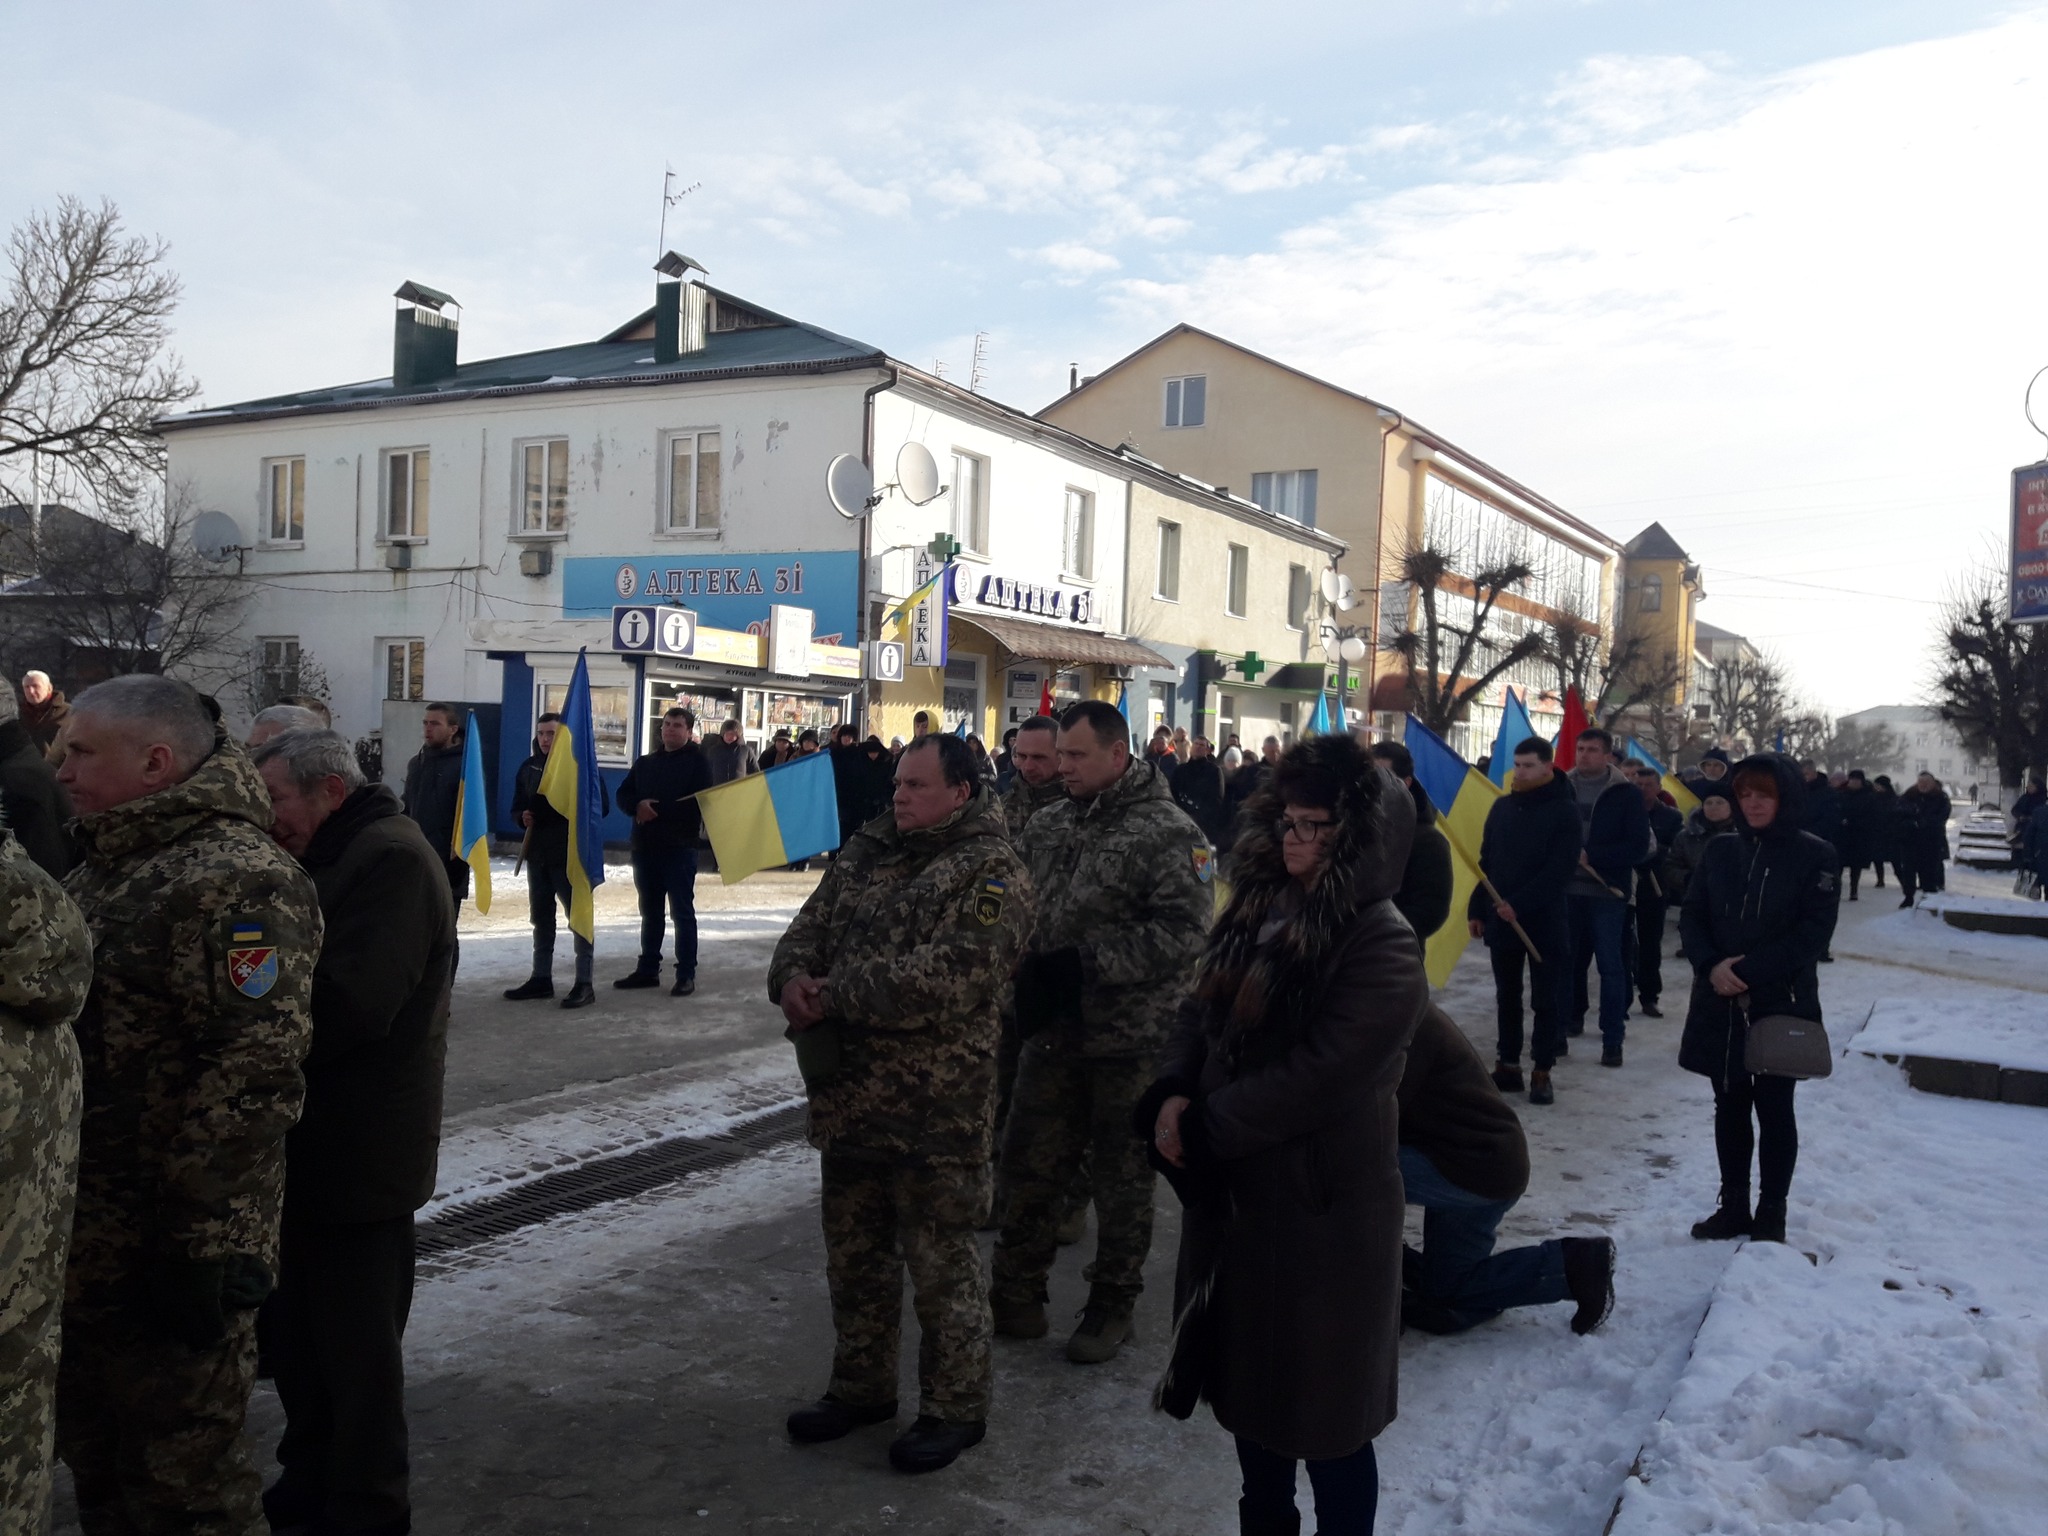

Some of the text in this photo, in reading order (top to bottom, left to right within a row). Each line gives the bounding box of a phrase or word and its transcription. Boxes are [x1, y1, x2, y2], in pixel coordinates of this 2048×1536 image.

[645, 568, 763, 596] АПТЕКА
[983, 574, 1069, 618] АПТЕКА
[914, 551, 931, 662] АПЕКА
[674, 662, 701, 672] ГАЗЕТИ
[725, 668, 757, 678] ЖУРНАЛИ
[821, 679, 858, 688] КАНЦТОВАРИ
